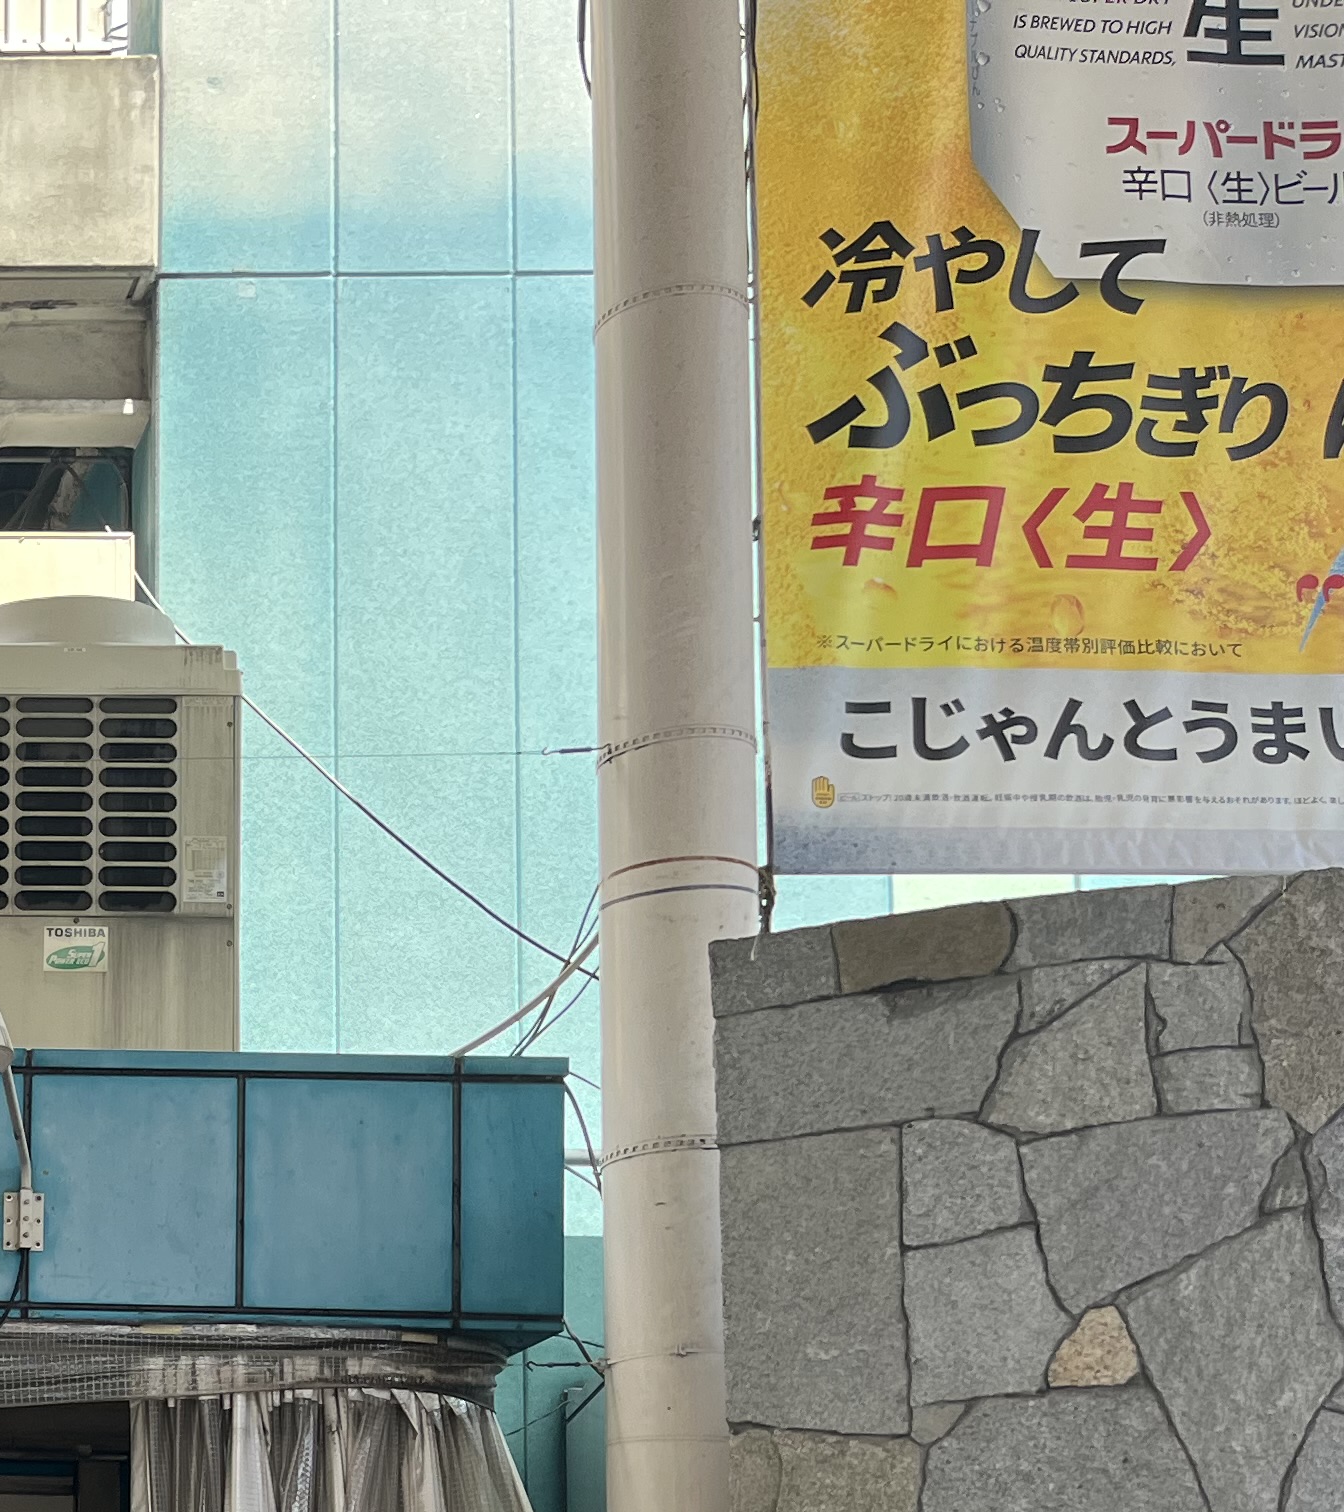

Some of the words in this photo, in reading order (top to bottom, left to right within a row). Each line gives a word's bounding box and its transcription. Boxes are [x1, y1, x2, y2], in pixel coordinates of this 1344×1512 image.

[1013, 15, 1028, 29] IS
[1030, 15, 1096, 33] BREWED
[1100, 20, 1124, 34] TO
[1126, 20, 1173, 35] HIGH
[1014, 44, 1078, 62] QUALITY
[1079, 49, 1177, 67] STANDARDS,
[1106, 117, 1342, 160] スーパードラ
[801, 220, 1167, 315] 冷やして
[806, 321, 1289, 461] ぶっちぎり
[810, 474, 1212, 571] 辛口〈生〉
[46, 927, 106, 939] TOSHIBA
